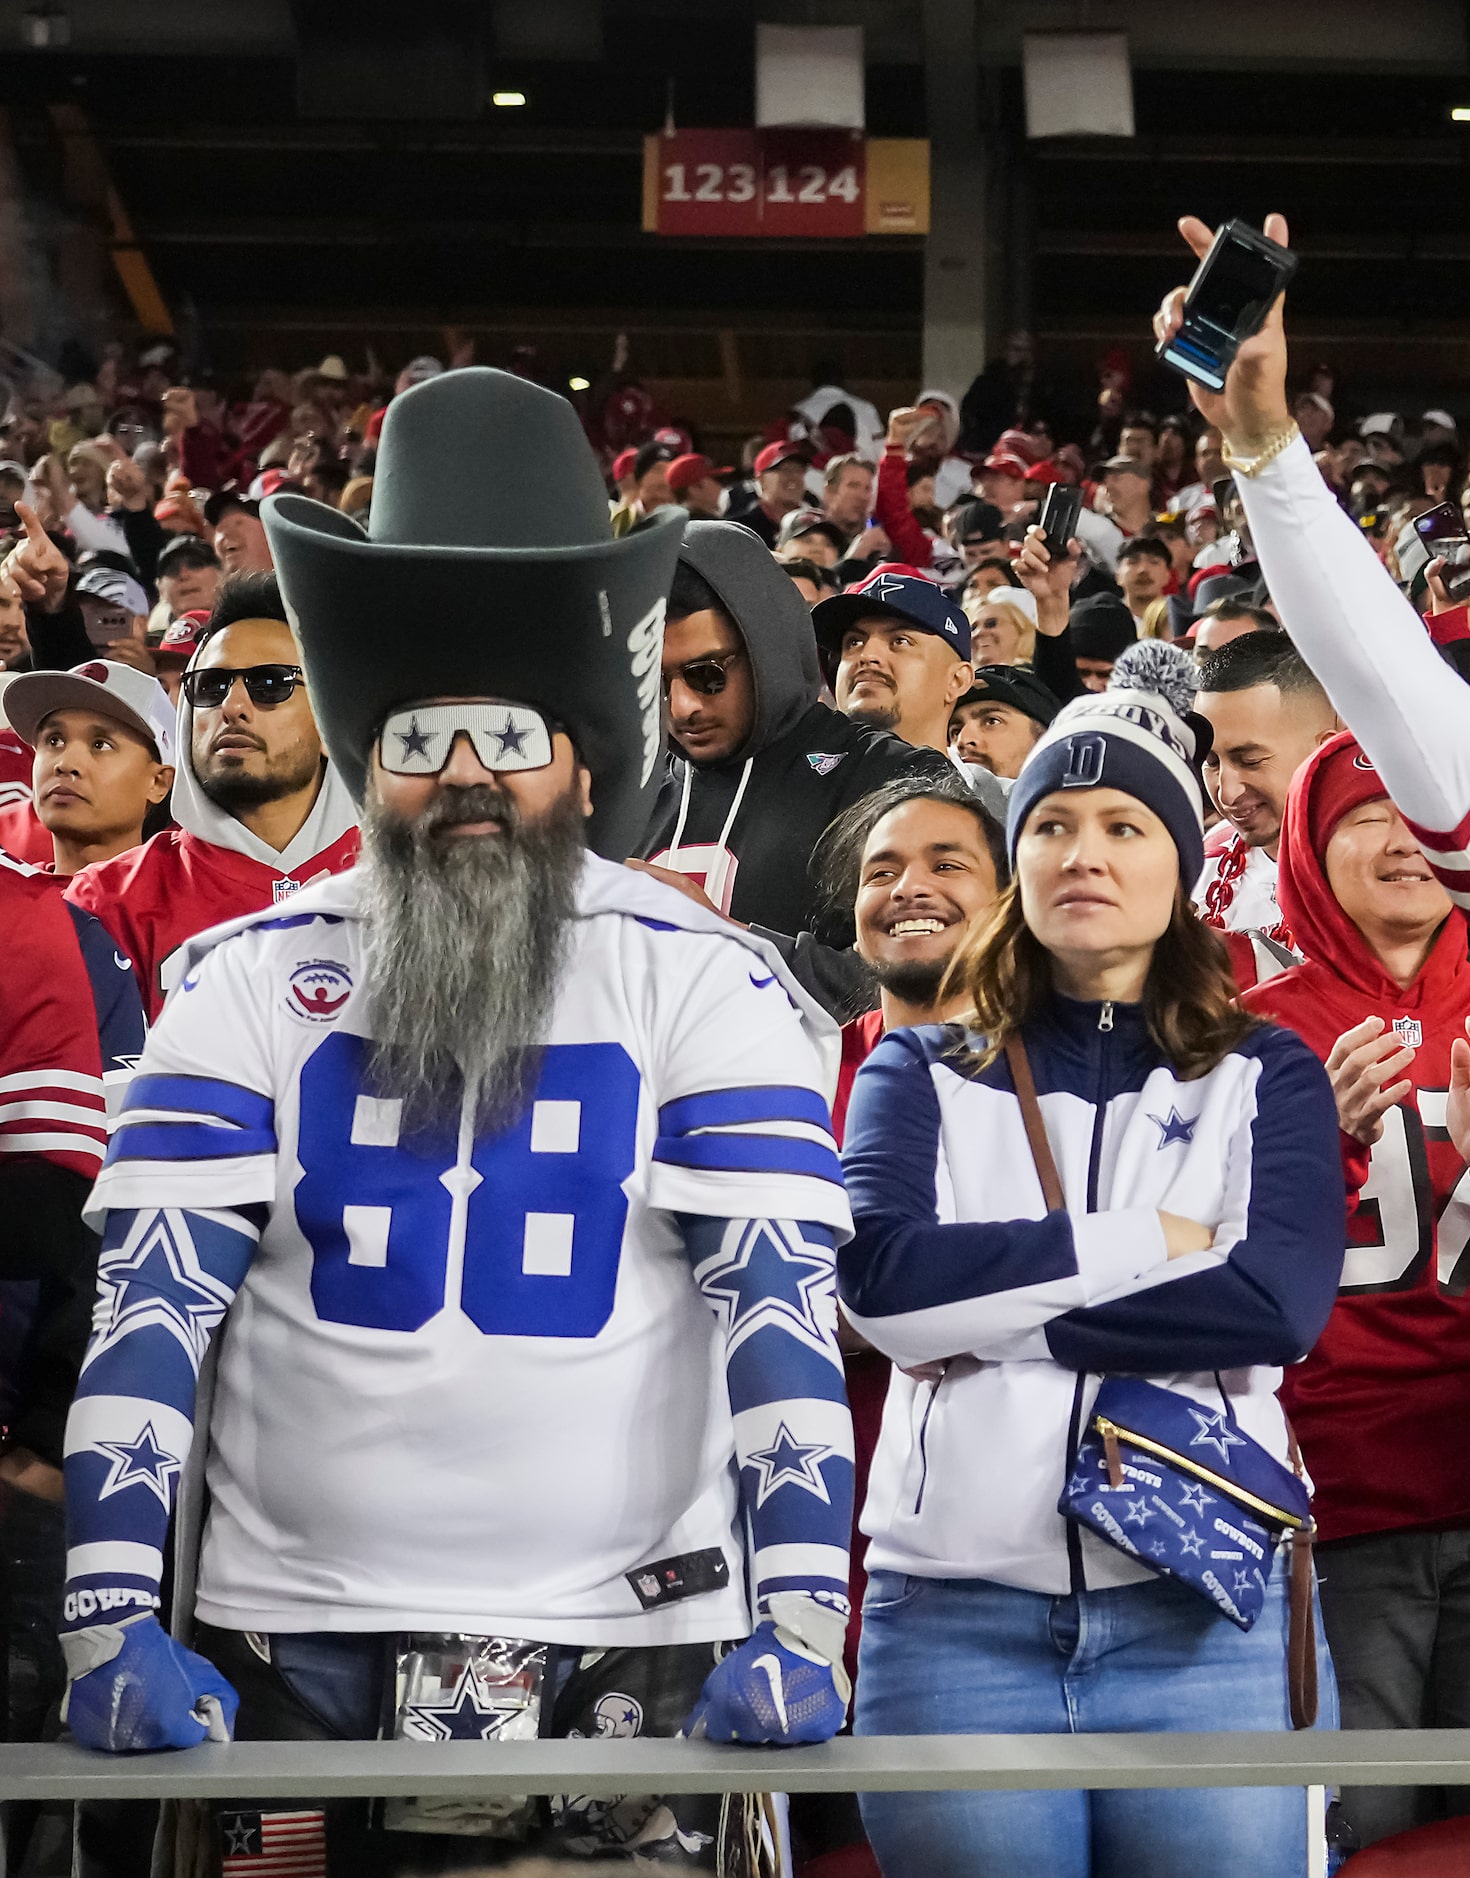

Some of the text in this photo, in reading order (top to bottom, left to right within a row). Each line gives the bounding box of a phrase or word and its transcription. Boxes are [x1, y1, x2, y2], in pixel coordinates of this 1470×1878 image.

[664, 162, 860, 203] 123 124
[1063, 737, 1107, 787] D
[293, 1031, 641, 1338] 88
[1214, 1517, 1265, 1561] COWBOYS
